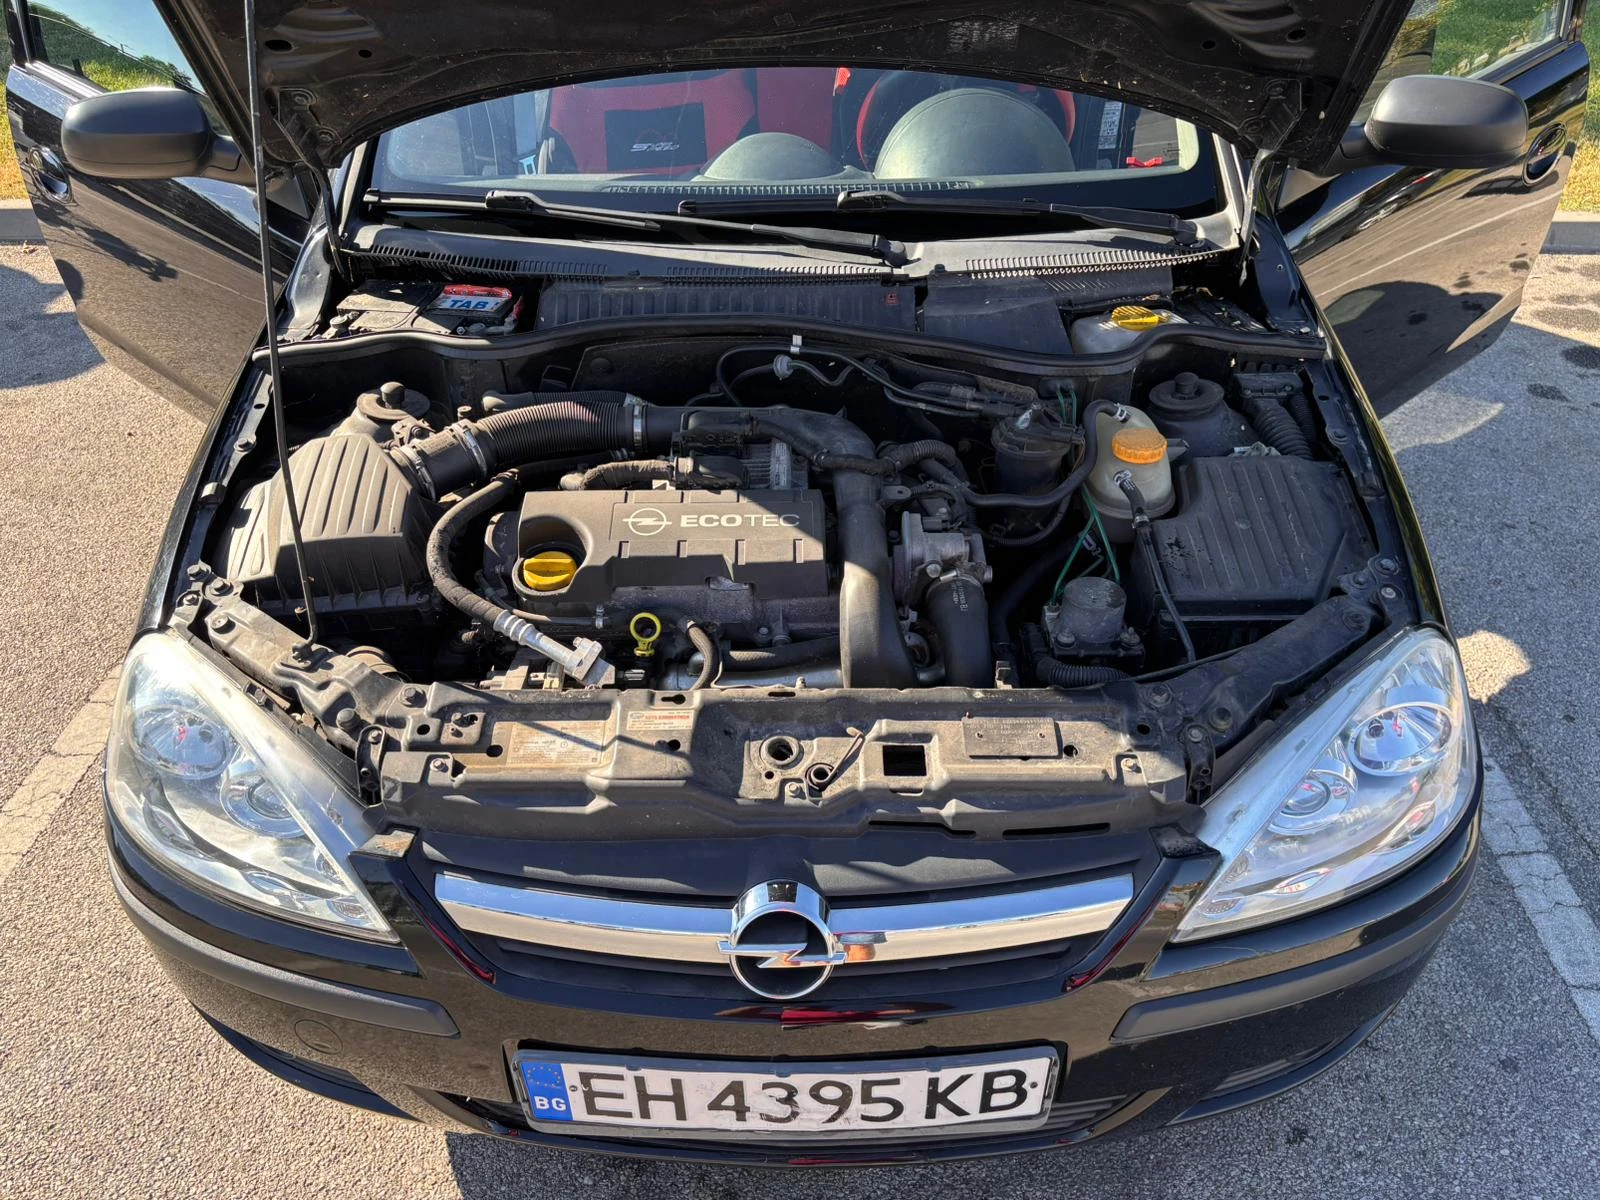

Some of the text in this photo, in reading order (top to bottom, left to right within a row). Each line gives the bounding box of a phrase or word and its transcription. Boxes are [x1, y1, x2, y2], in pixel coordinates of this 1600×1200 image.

[449, 299, 489, 310] TAB
[680, 514, 801, 528] ECOTEC
[533, 1095, 567, 1112] BG
[578, 1069, 1028, 1124] EH 4395 KB
